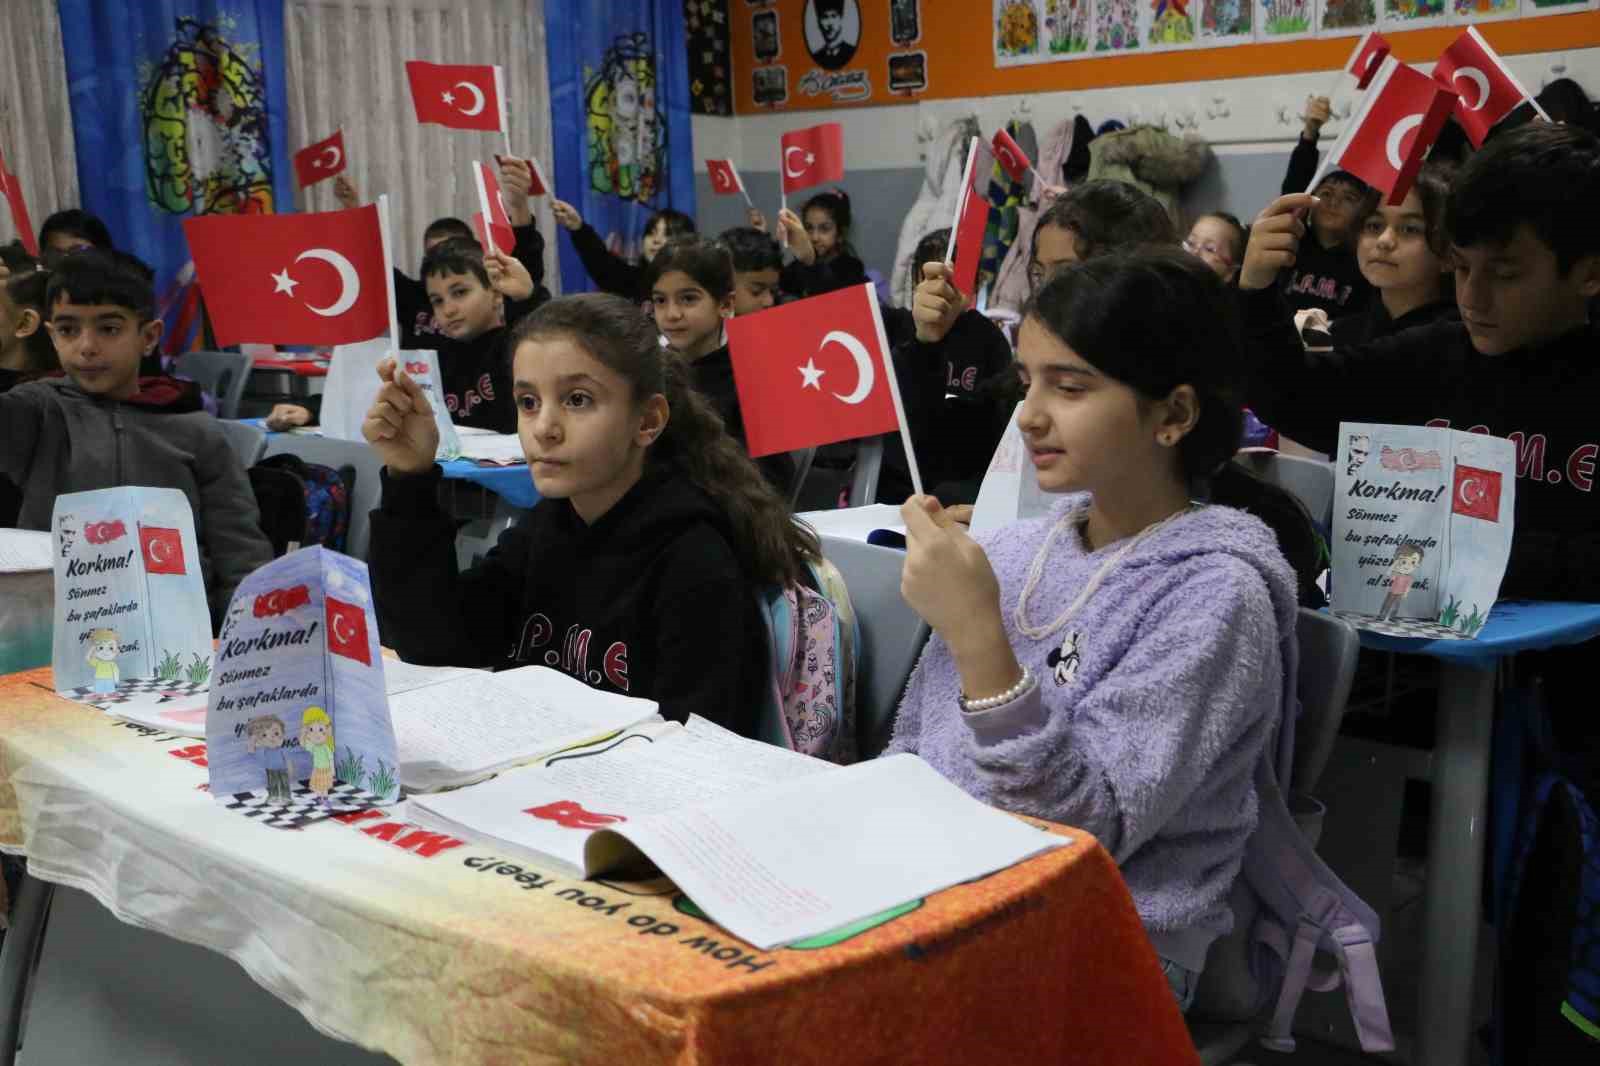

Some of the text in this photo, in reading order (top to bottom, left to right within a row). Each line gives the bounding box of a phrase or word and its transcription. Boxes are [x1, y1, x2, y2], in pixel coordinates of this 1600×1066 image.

[1348, 479, 1446, 503] Korkma!
[1346, 507, 1399, 523] Sönmez
[1344, 529, 1362, 543] bu
[66, 549, 134, 578] Korkma!
[1366, 574, 1383, 587] al
[67, 586, 107, 600] Sönmez
[67, 600, 138, 622] bu şafaklarda
[221, 621, 318, 661] Korkma!
[218, 666, 271, 686] Sönmez
[216, 683, 319, 711] bu şafaklarda
[463, 855, 776, 973] How do you feel?
